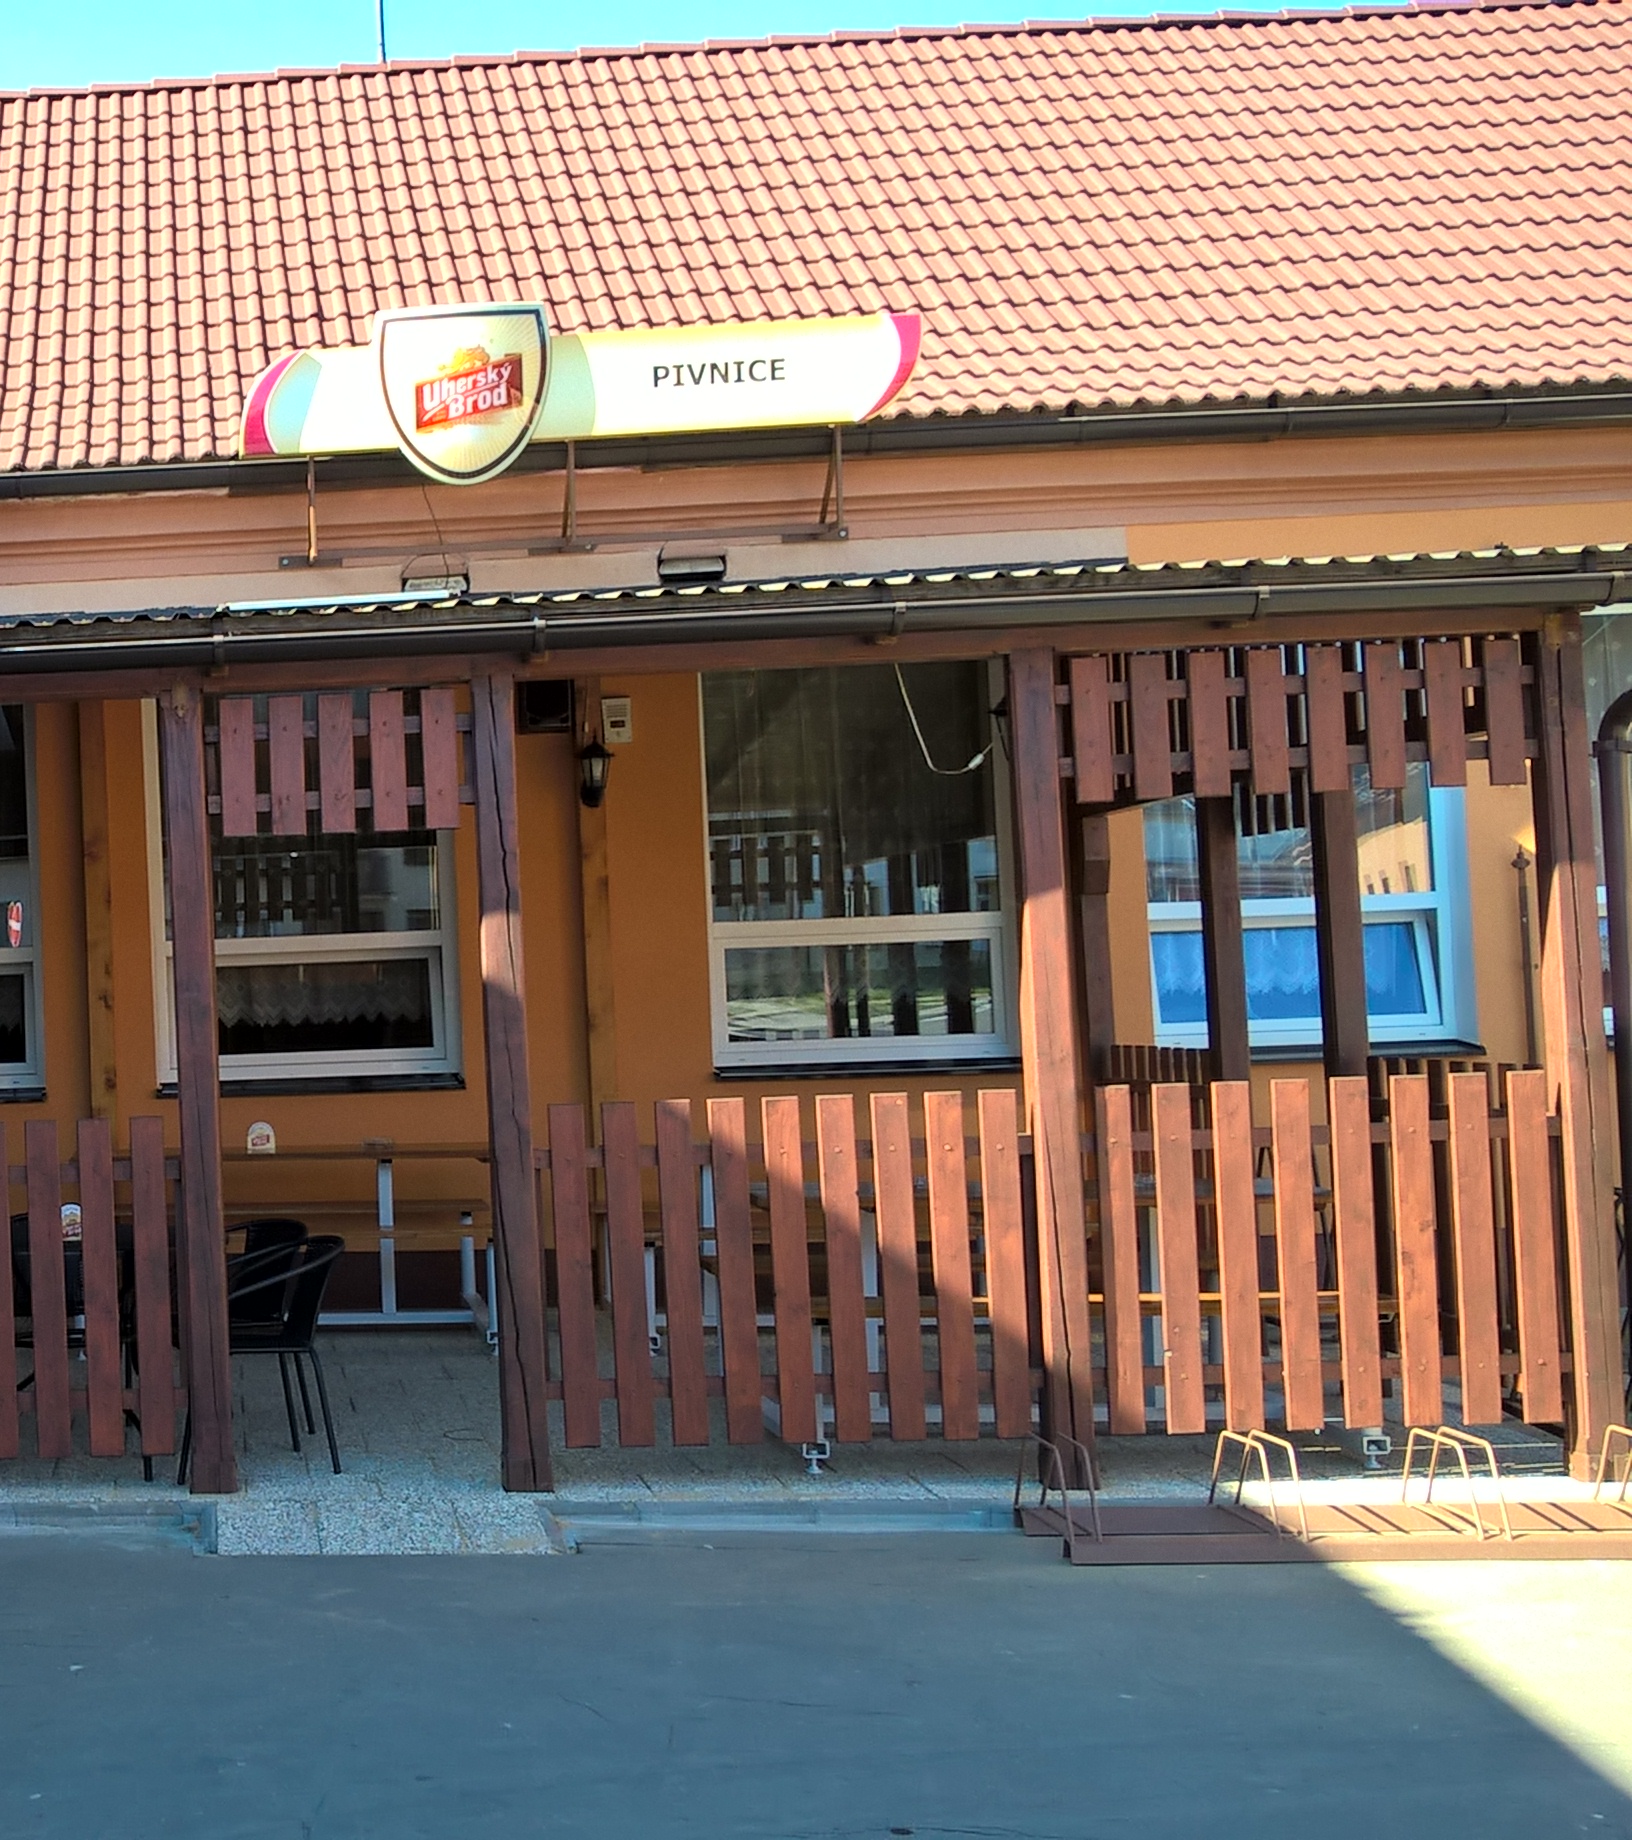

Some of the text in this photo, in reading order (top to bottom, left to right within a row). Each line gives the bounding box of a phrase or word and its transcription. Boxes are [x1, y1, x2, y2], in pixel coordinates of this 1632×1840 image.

[422, 362, 513, 412] Uherský
[653, 358, 786, 388] PIVNICE
[445, 382, 509, 419] Brod
